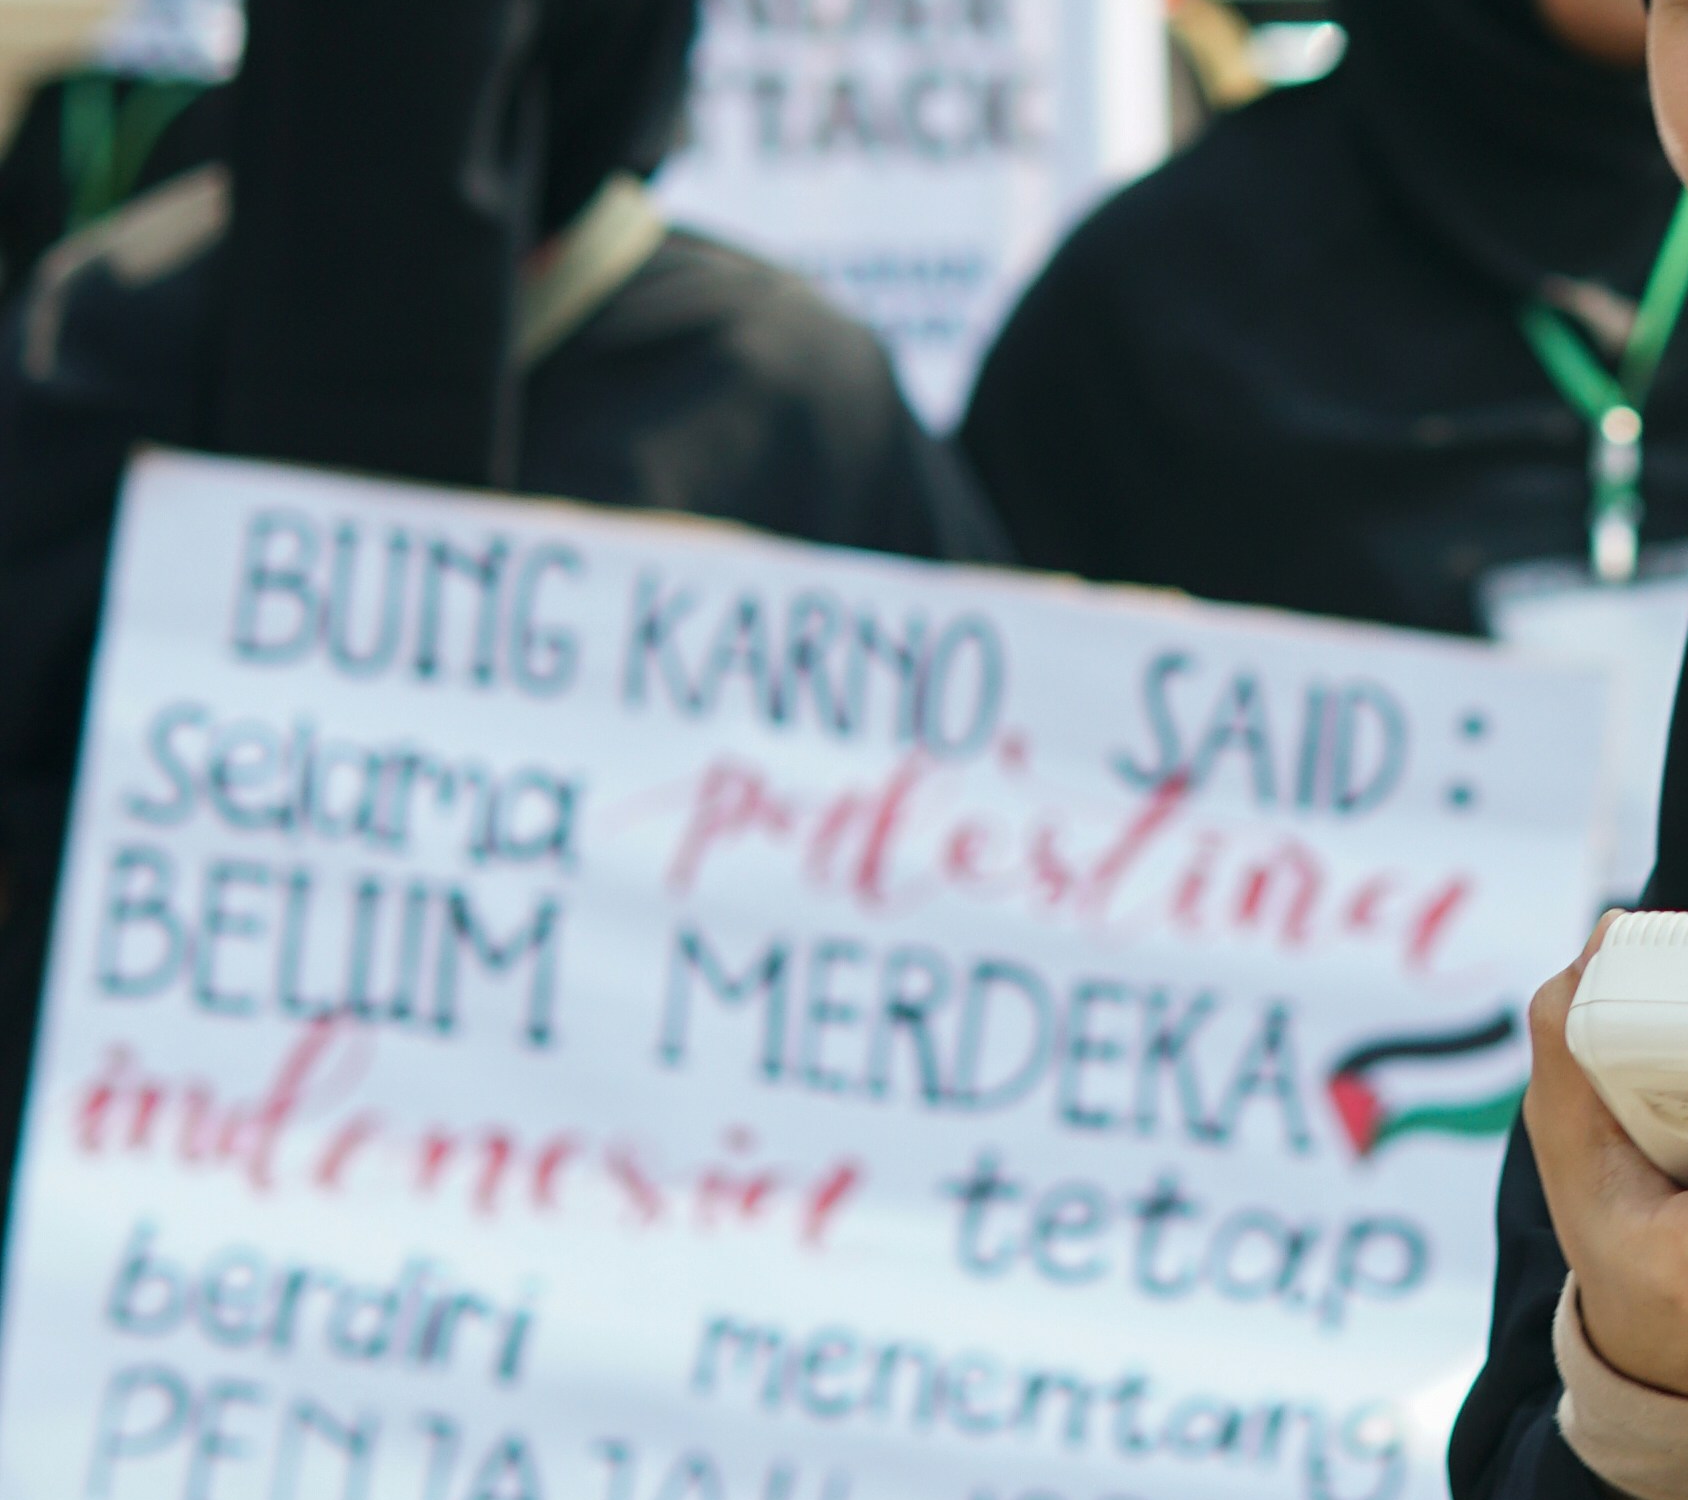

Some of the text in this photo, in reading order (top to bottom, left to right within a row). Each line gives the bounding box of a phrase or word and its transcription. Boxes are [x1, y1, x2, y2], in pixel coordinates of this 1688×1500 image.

[228, 503, 588, 698] BUNG
[1108, 642, 1406, 818] SAID
[118, 698, 588, 878] Selama
[93, 840, 1312, 1155] BELUM MERDEKA
[107, 1222, 533, 1388] berdiri
[942, 1152, 1435, 1326] tetap
